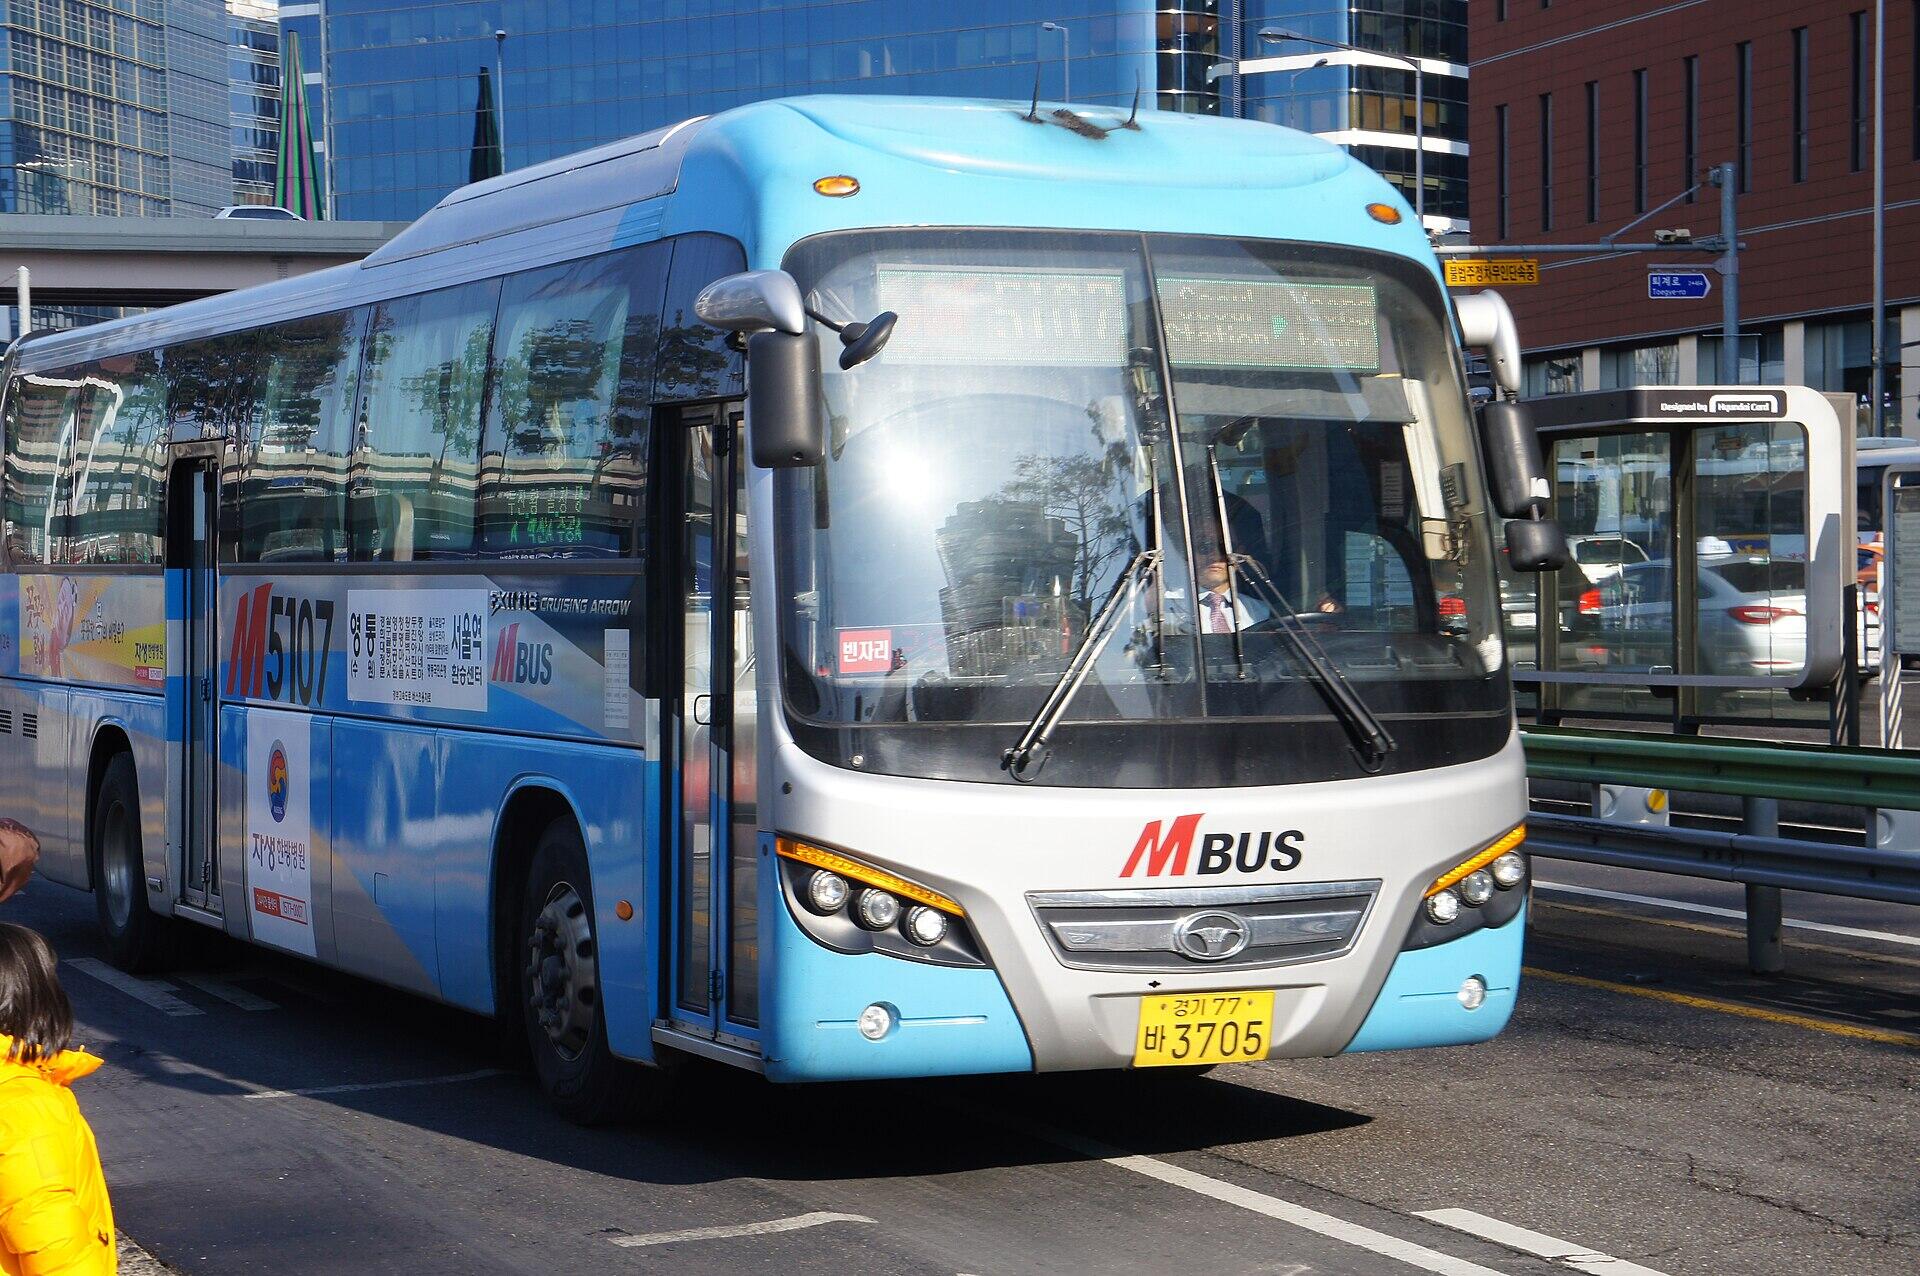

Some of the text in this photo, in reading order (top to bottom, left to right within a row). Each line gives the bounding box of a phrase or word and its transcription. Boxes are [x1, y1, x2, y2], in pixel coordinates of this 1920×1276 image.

[1651, 276, 1681, 287] 퇴계로
[1660, 402, 1770, 413] Designed by Hyundai Card
[540, 597, 588, 614] CRUISING
[590, 600, 632, 615] ARROW
[350, 612, 376, 657] 영통
[451, 612, 482, 660] 서울역
[842, 639, 889, 663] 빈자리
[451, 663, 482, 686] 환승센터
[1212, 997, 1241, 1015] 77
